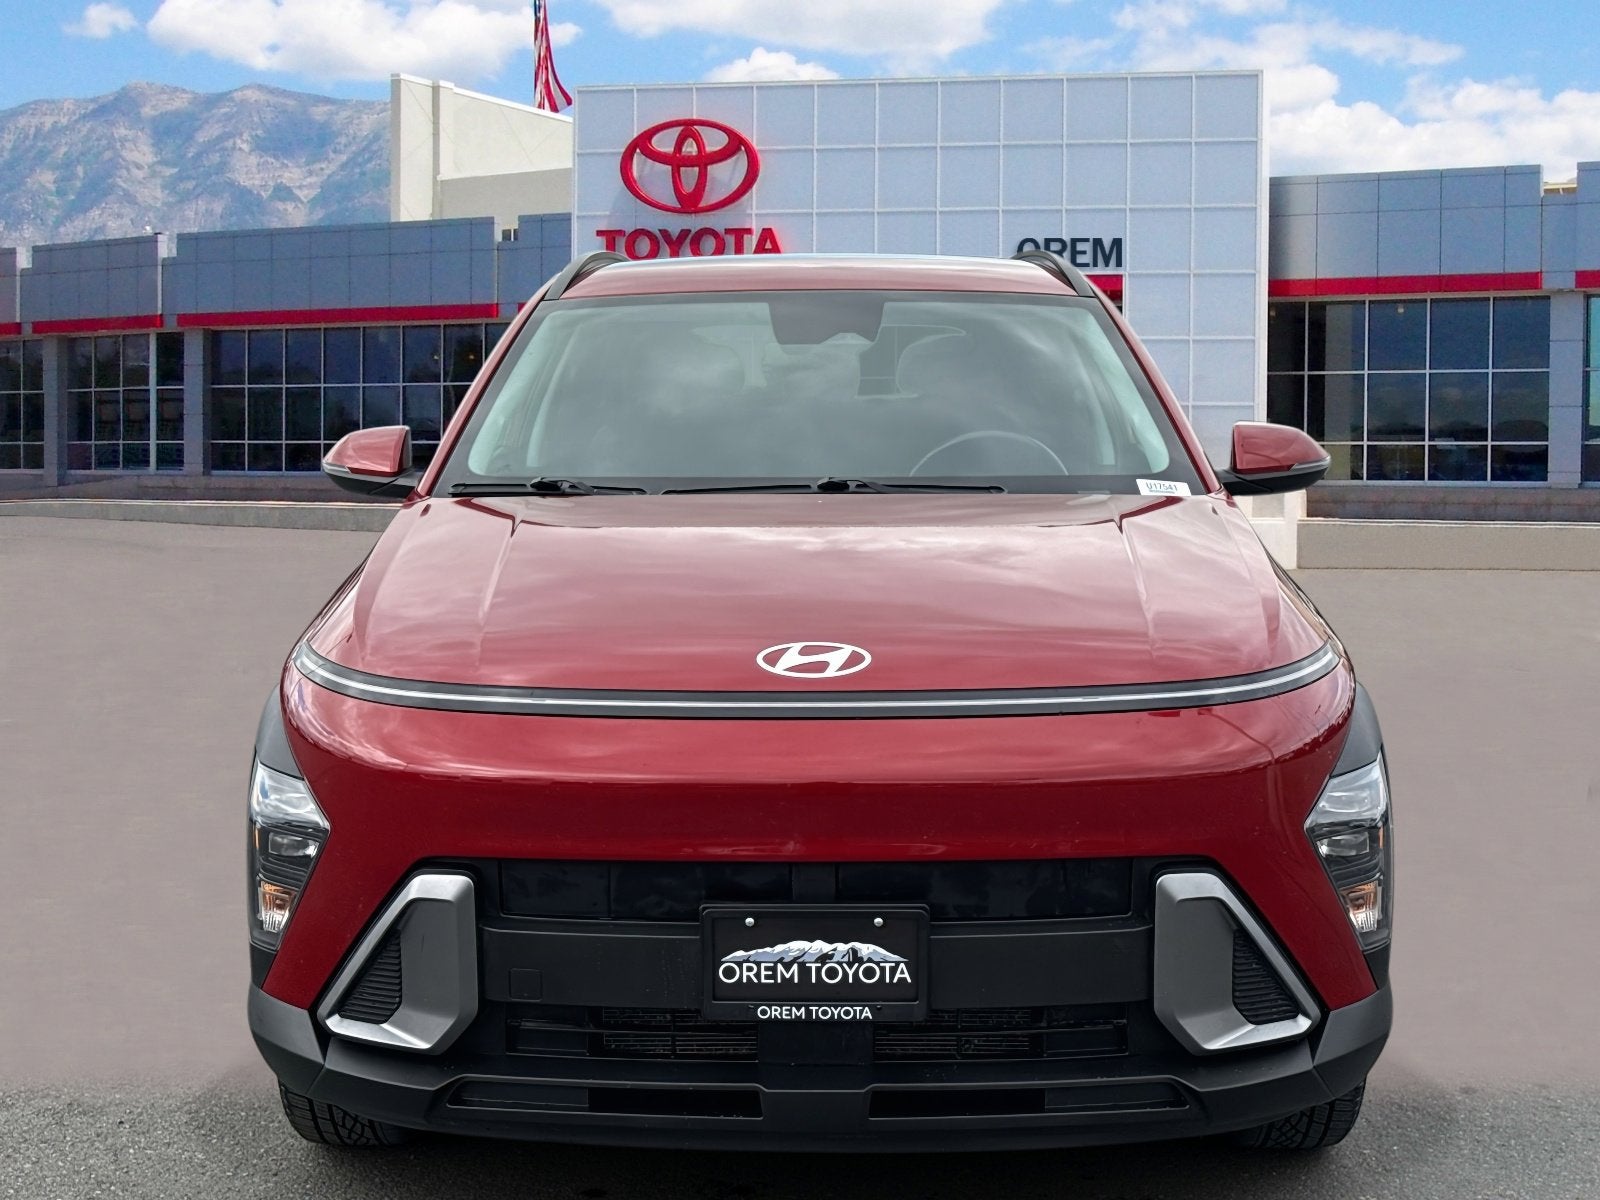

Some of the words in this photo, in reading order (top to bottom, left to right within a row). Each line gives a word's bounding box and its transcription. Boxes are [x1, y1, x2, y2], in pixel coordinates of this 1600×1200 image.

[596, 227, 782, 260] TOYOTA
[718, 962, 799, 984] OREM
[806, 962, 912, 984] TOYOTA
[757, 1005, 805, 1020] OREM
[809, 1006, 873, 1020] TOYOTA
